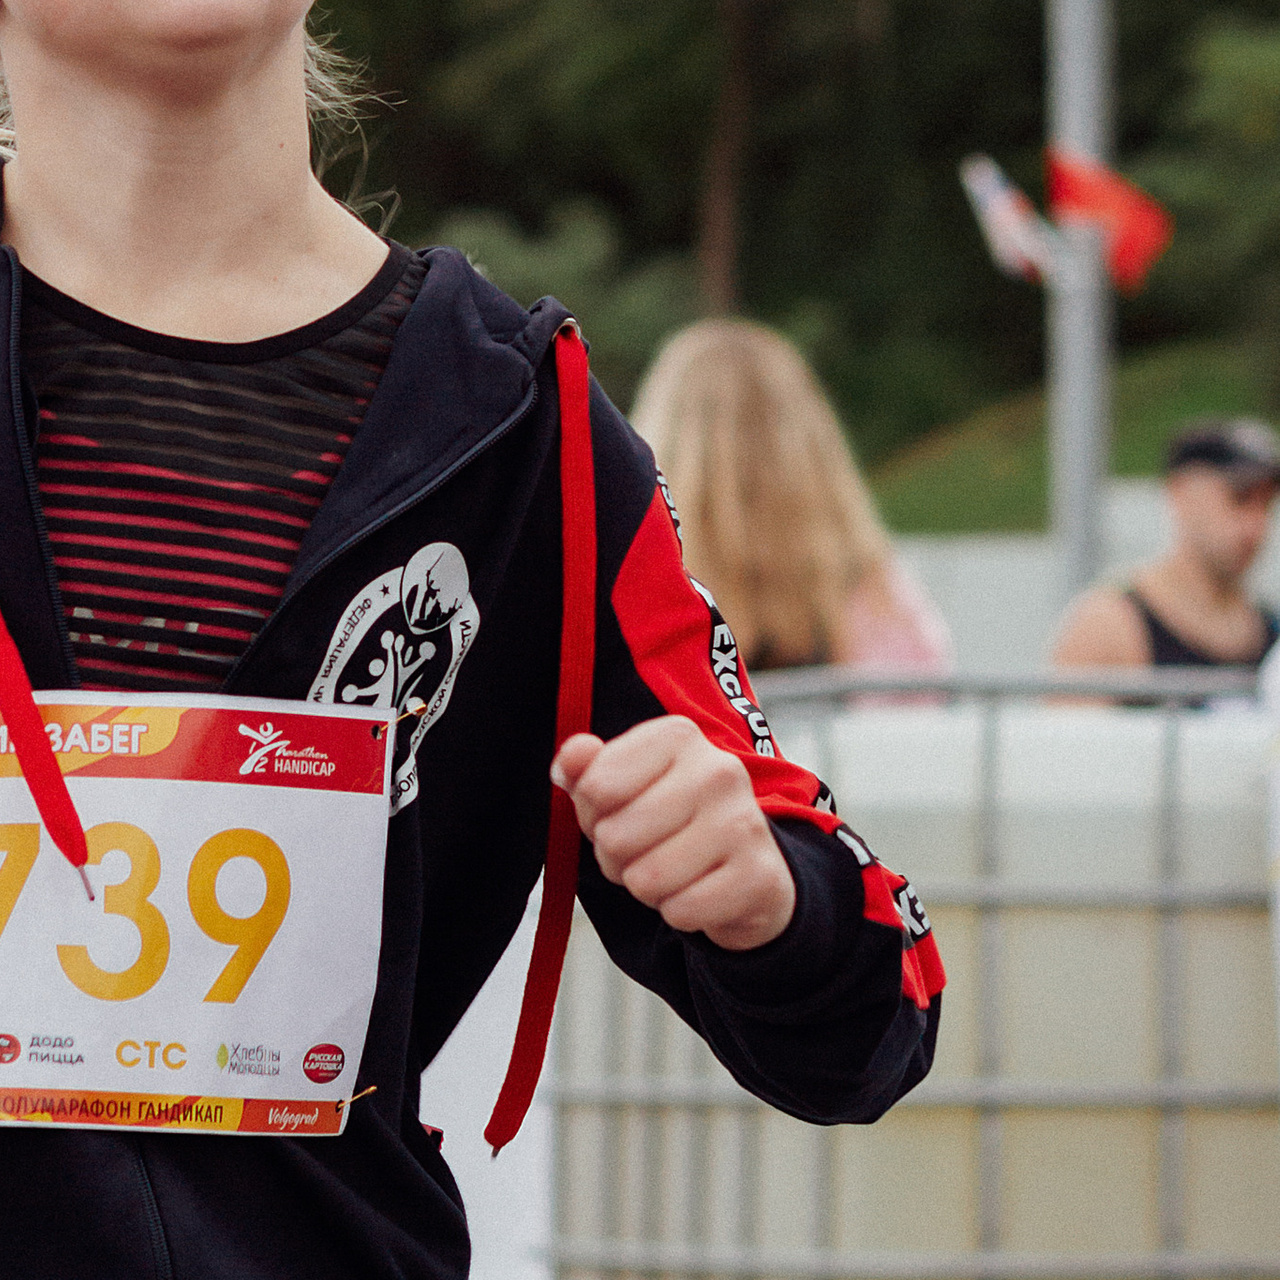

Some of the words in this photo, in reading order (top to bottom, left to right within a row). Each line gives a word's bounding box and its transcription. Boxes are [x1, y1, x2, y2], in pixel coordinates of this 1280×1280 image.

[321, 598, 372, 678] ФЕДЕРАЦИЯ
[44, 721, 149, 755] ЗАБЕГ
[274, 758, 337, 777] HANDICAP
[29, 1035, 75, 1048] ДОДО
[28, 1051, 85, 1065] ПИЦЦА
[115, 1039, 188, 1070] СТС
[308, 1052, 344, 1063] РУССКАЯ
[138, 1101, 224, 1124] ГАНДИКАП
[267, 1106, 320, 1131] Volgograd
